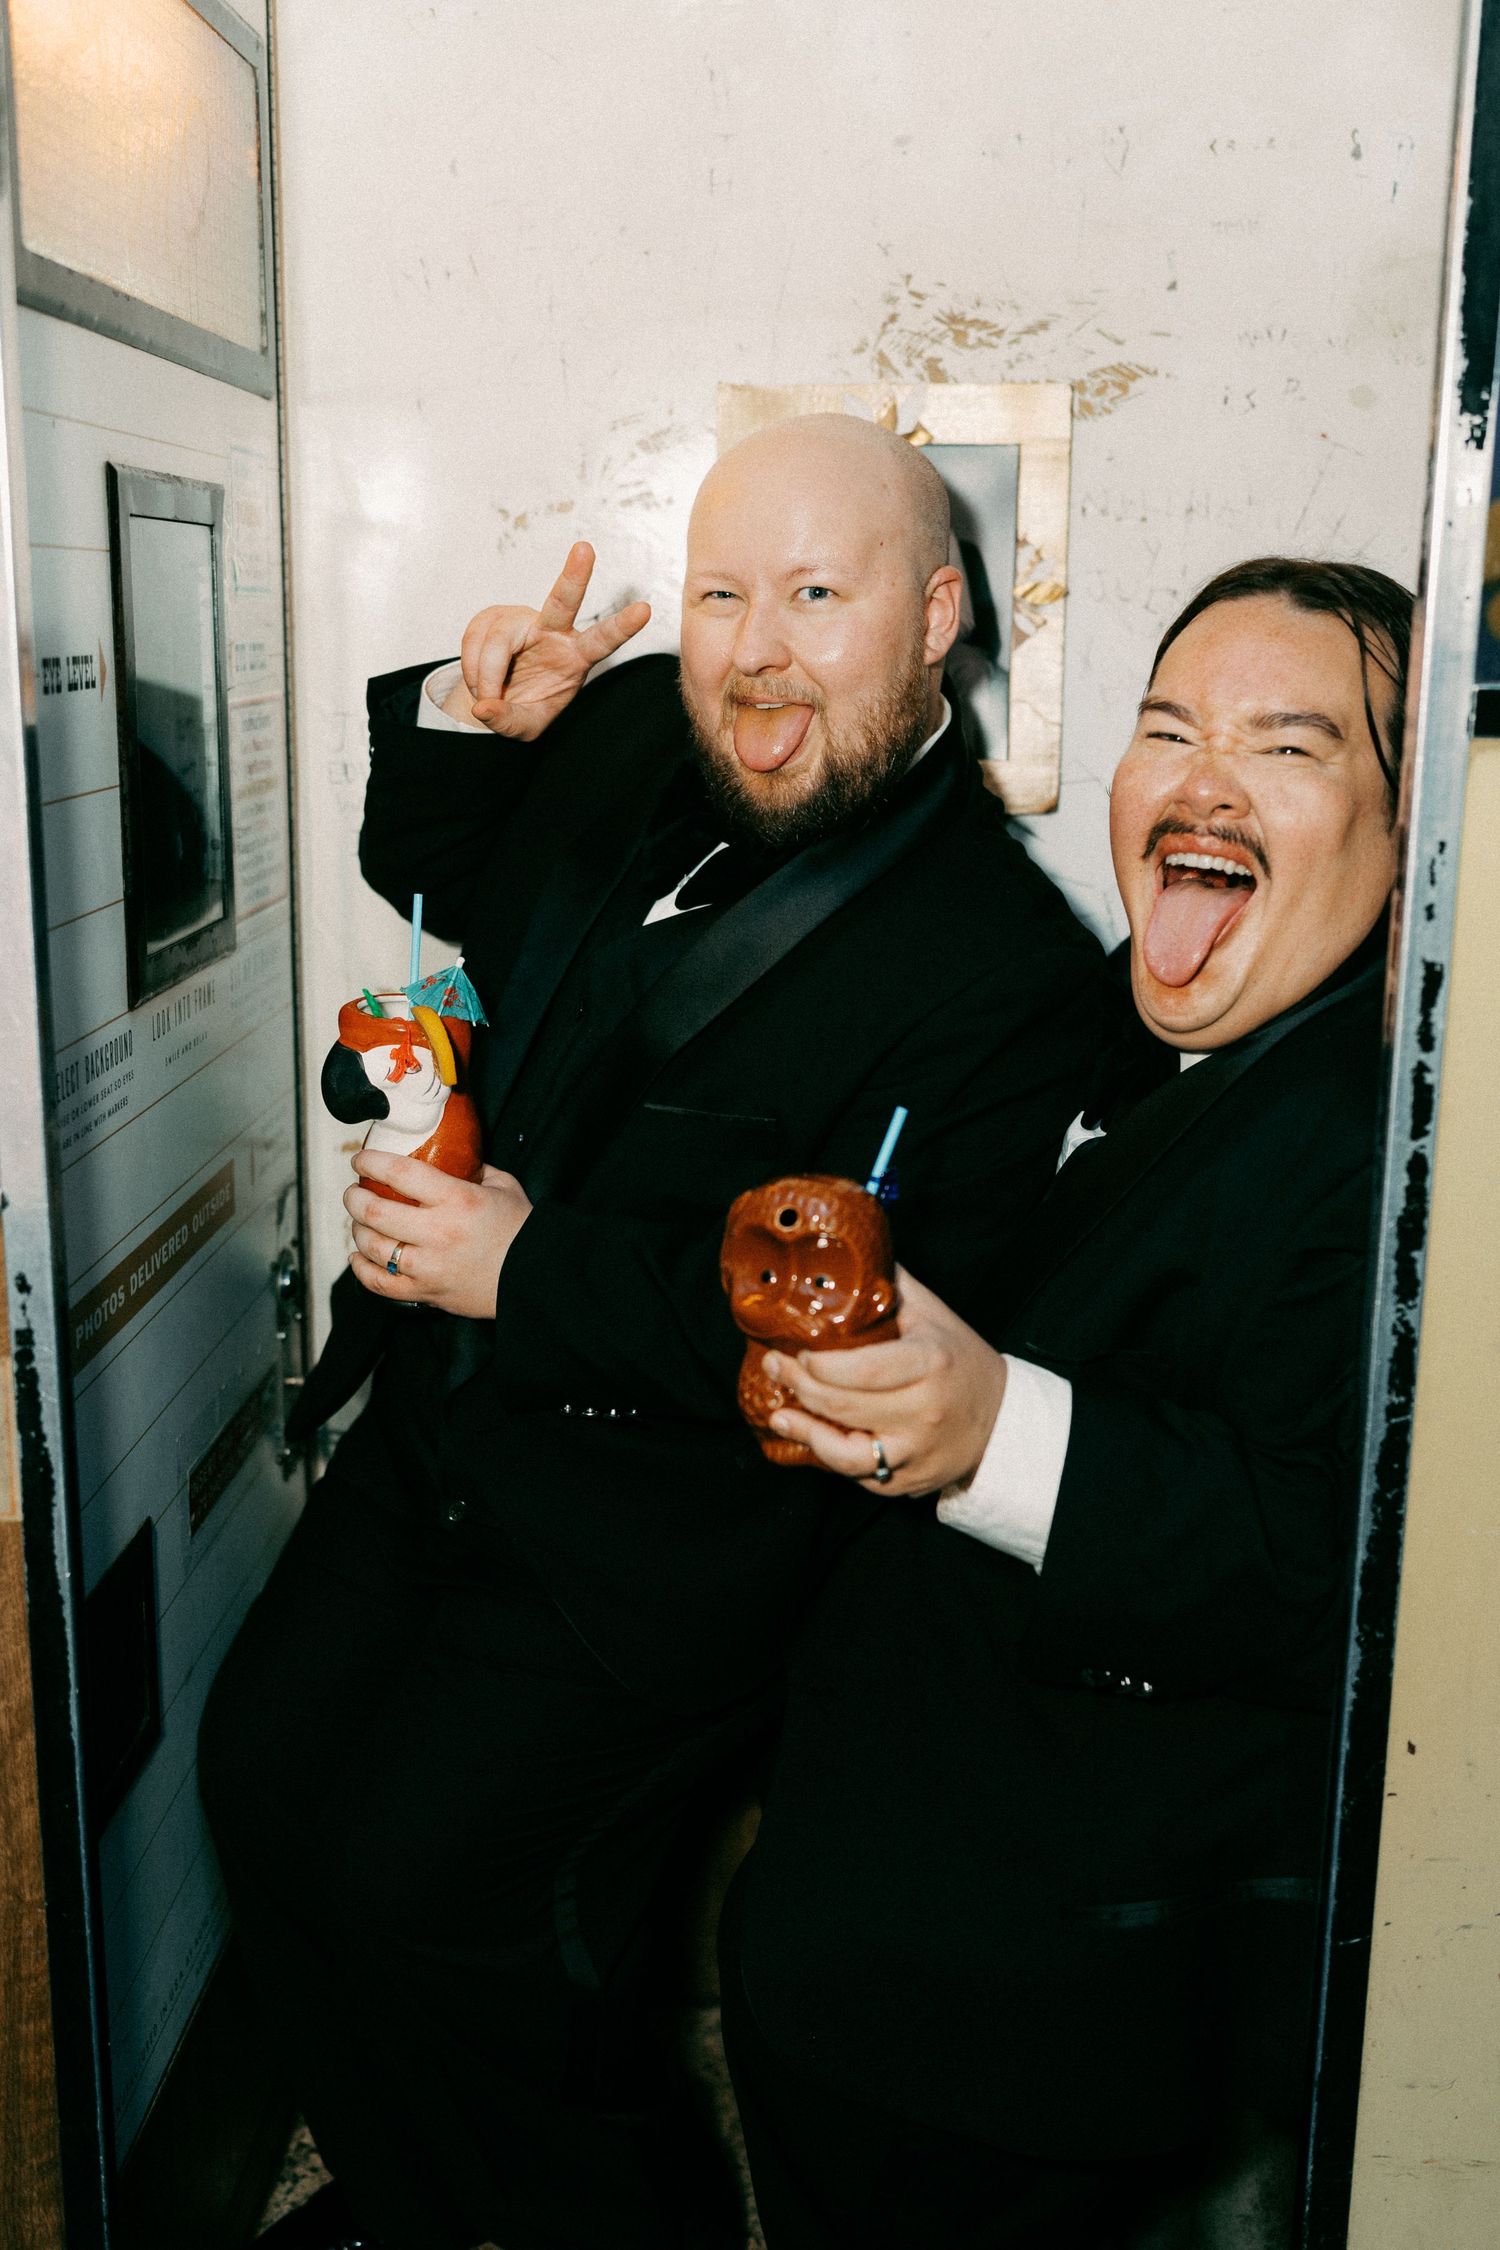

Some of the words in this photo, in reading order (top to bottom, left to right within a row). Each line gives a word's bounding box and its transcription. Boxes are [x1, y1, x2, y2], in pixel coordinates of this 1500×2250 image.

[42, 656, 62, 695] EYE
[66, 654, 96, 692] LEVEL
[152, 1006, 171, 1041] LOOK
[174, 993, 190, 1027] INTO
[194, 979, 215, 1015] FRAME
[55, 1060, 80, 1105] ELECT
[85, 1029, 133, 1085] BACKGROUND
[165, 1049, 180, 1067] SMILE
[80, 1093, 99, 1115] LOWER
[100, 1084, 113, 1101] SEAT
[114, 1078, 122, 1091] SO
[123, 1069, 134, 1085] EYES
[81, 1121, 93, 1138] LINE
[94, 1112, 107, 1127] WITH
[107, 1095, 129, 1118] MARKERS
[75, 1284, 126, 1349] PHOTOS
[130, 1224, 189, 1296] DELIVERED
[192, 1183, 231, 1233] OUTSIDE
